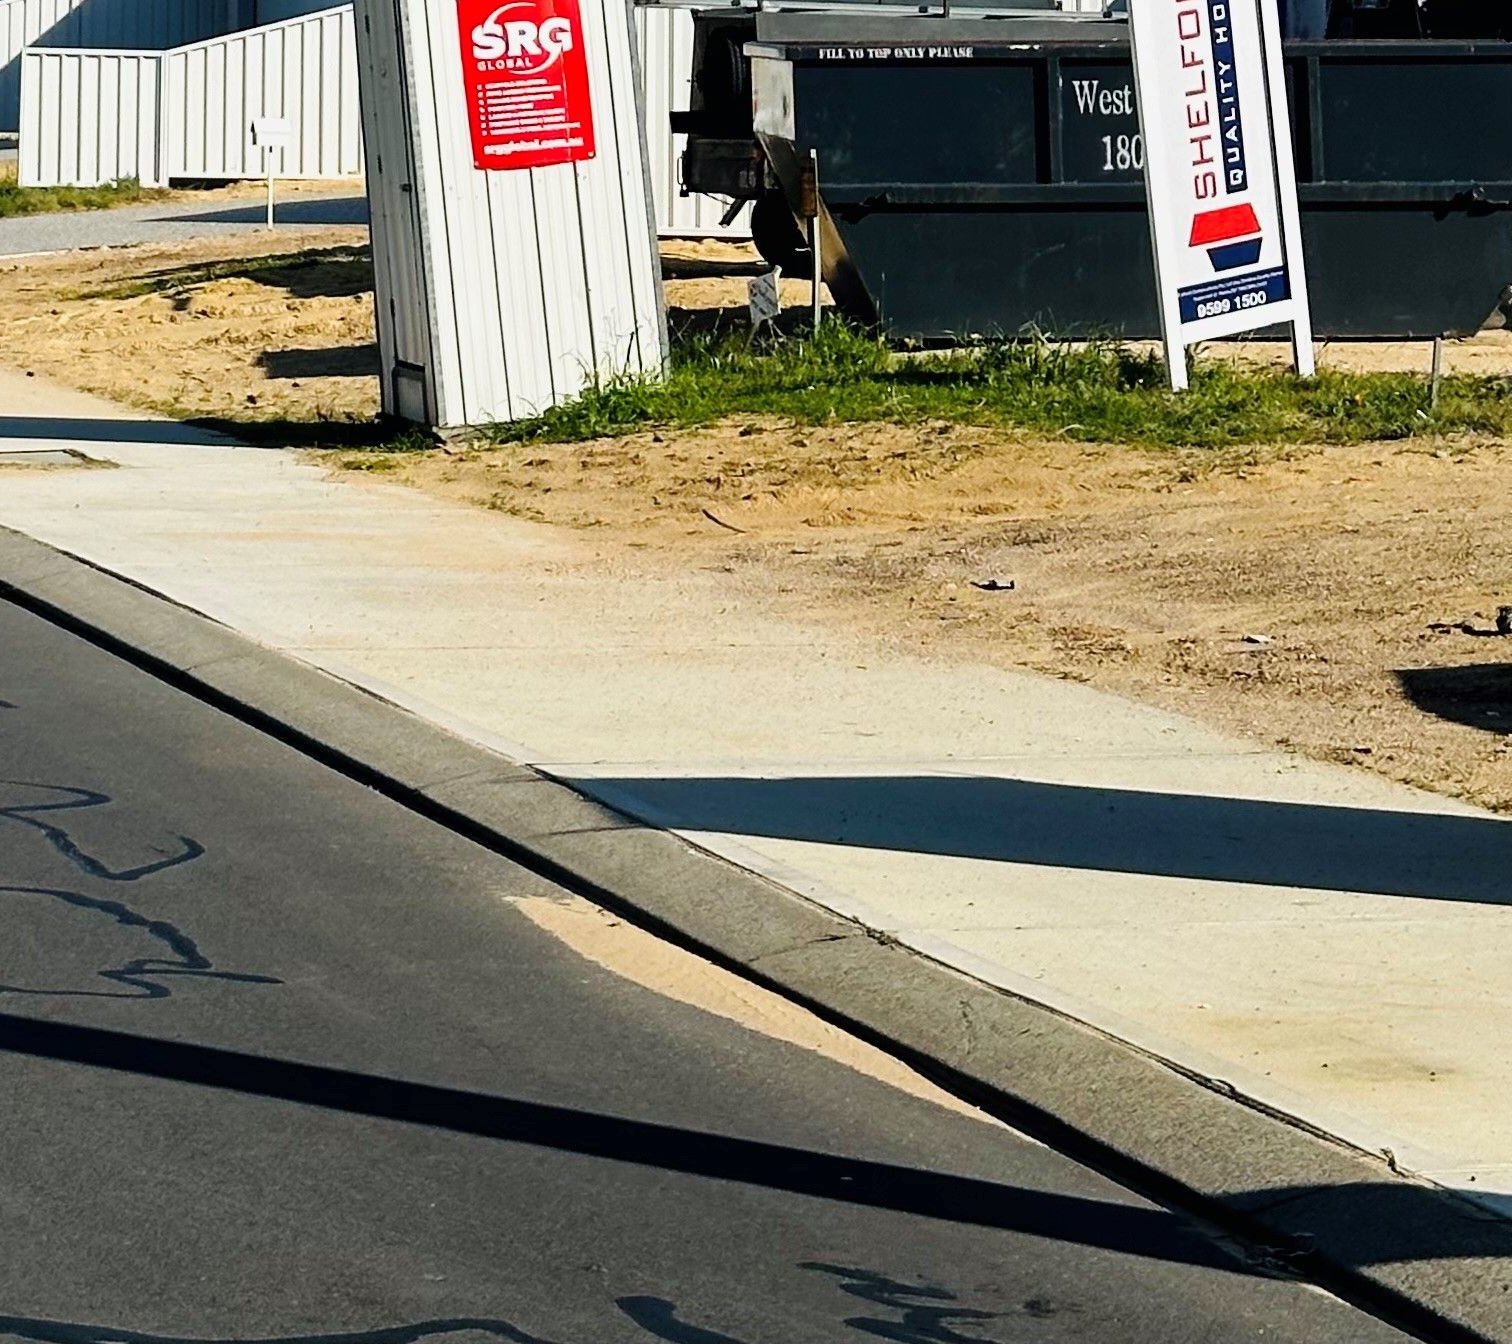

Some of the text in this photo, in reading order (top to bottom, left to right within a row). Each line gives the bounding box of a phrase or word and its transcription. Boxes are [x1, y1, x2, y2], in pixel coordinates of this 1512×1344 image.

[471, 16, 574, 60] SRG
[819, 47, 974, 59] FILL TO TOP ONLY PLEASE
[477, 58, 534, 71] GLOBAL
[1072, 80, 1134, 115] West
[1218, 60, 1244, 186] QUALITY
[1102, 135, 1144, 171] 180
[1234, 291, 1267, 310] 1500
